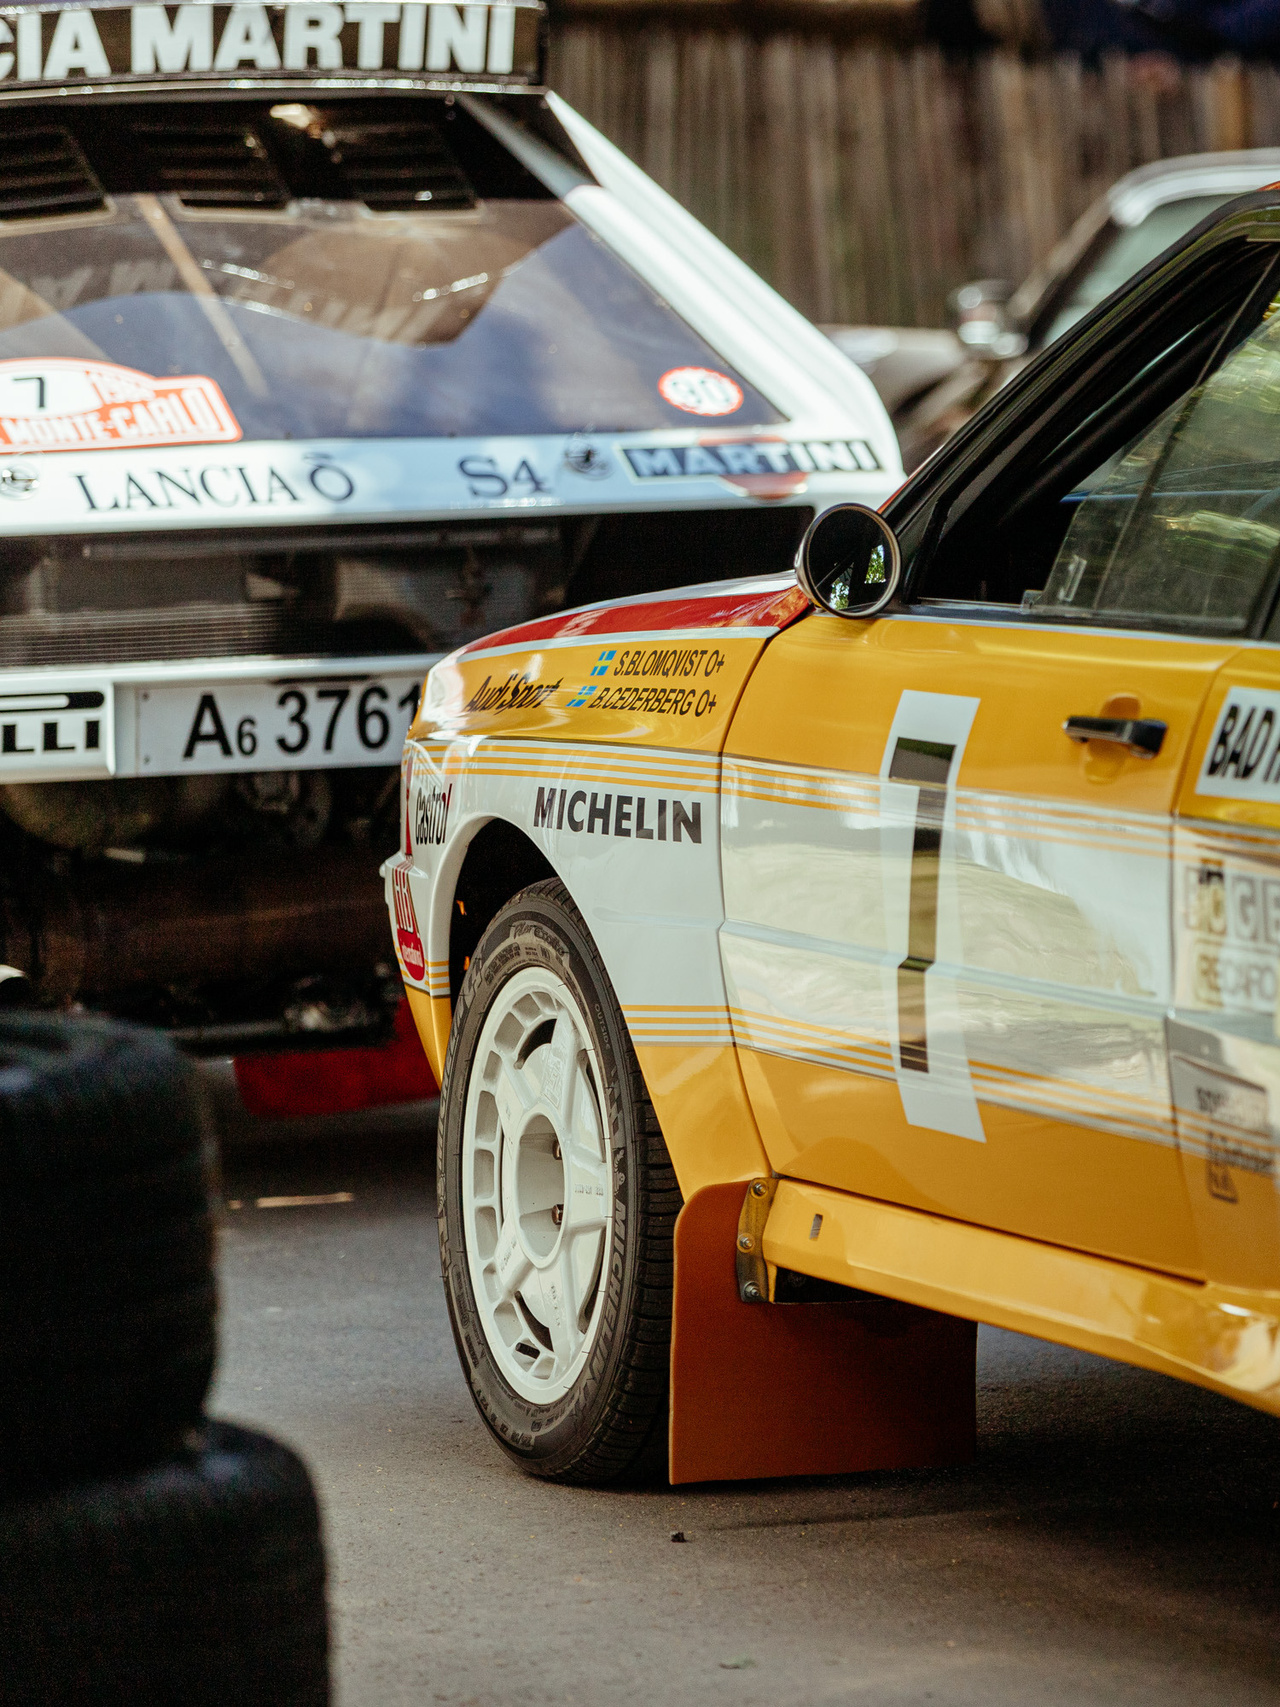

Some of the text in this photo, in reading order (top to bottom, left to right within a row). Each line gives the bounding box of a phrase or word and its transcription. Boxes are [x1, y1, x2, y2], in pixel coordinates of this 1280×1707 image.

[0, 3, 516, 81] IA MARTINI
[12, 375, 46, 410] 7
[458, 454, 553, 498] S4
[628, 441, 879, 478] MARTINI
[74, 464, 306, 513] LANCIA
[613, 649, 709, 678] S.BLOMQVIST
[463, 674, 519, 713] Audi
[588, 686, 697, 716] B.CEDERBERG
[183, 693, 259, 760] A6
[1206, 702, 1276, 780] BAD
[415, 783, 453, 845] Castrol
[532, 785, 703, 845] MICHELIN
